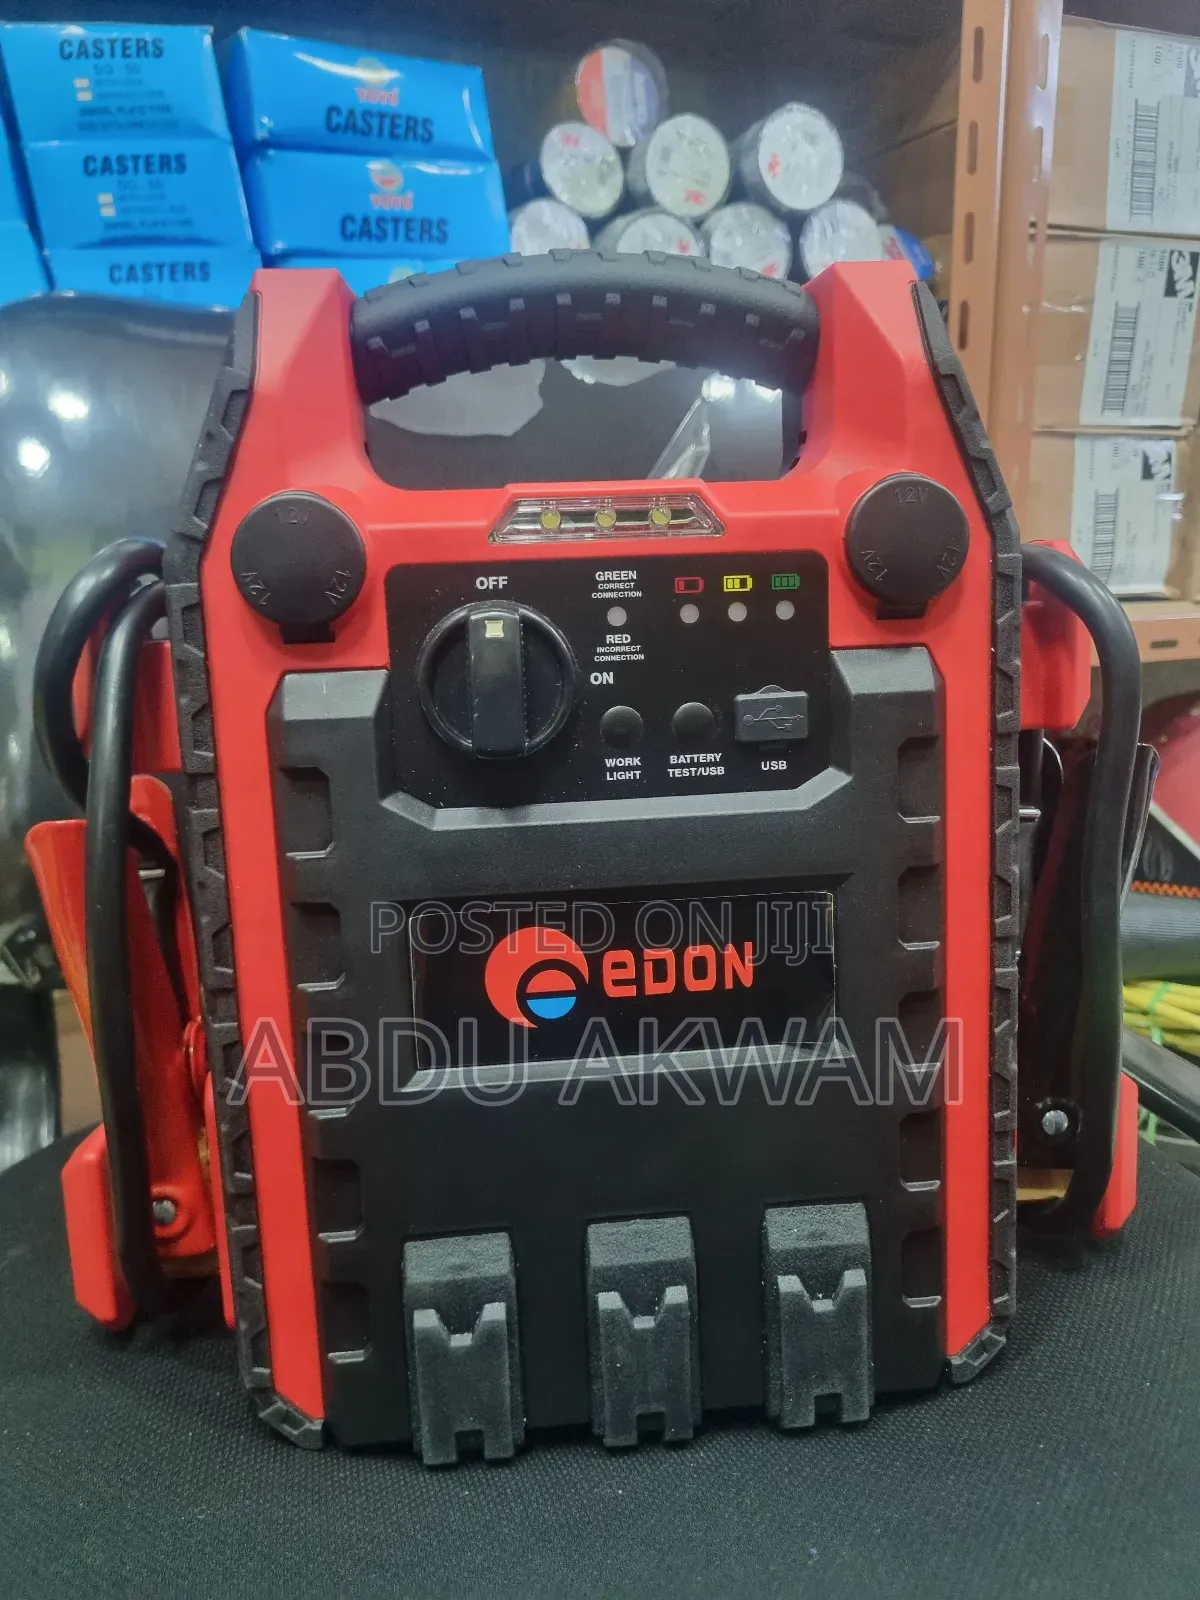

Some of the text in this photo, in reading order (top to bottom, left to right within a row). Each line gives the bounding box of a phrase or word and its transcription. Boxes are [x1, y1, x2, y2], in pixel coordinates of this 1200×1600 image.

[60, 38, 165, 60] CASTERS
[325, 105, 434, 144] CASTERS
[83, 153, 187, 177] CASTERS
[340, 214, 449, 245] CASTERS
[109, 261, 211, 285] CASTERS
[595, 571, 637, 581] GREEN
[476, 576, 509, 590] OFF
[598, 582, 635, 590] CORRECT
[592, 591, 642, 599] CONNECTION
[606, 634, 631, 644] RED
[597, 645, 641, 653] INCORRECT
[594, 654, 645, 662] CONNECTION
[590, 672, 614, 685] ON
[605, 757, 641, 767] WORK
[670, 753, 723, 764] BATTERY
[761, 760, 788, 771] USB
[606, 770, 642, 781] LIGHT
[668, 766, 725, 778] TEST/USB
